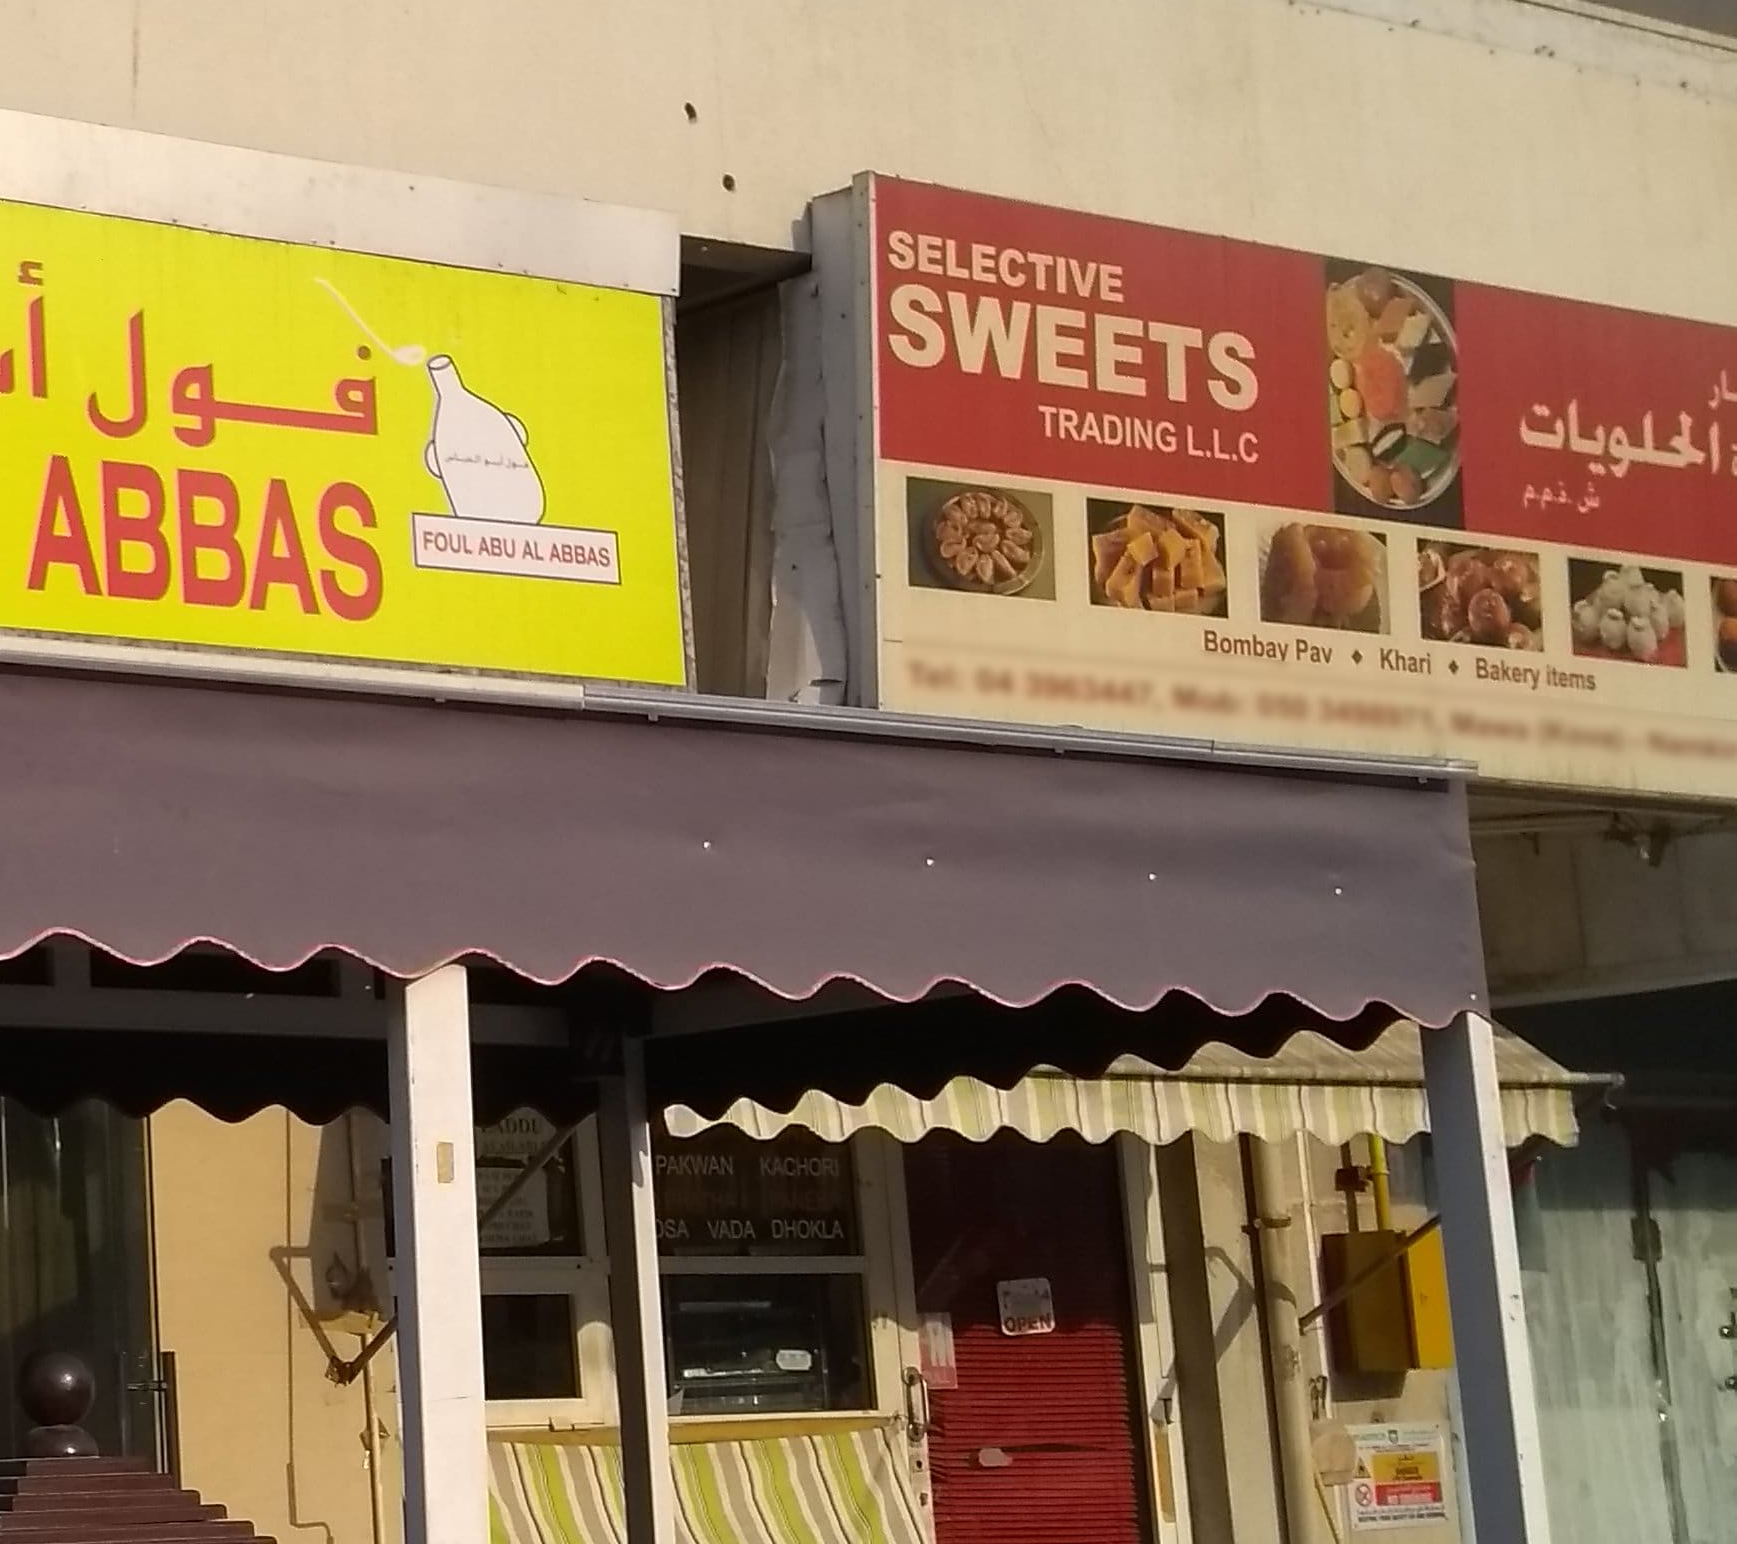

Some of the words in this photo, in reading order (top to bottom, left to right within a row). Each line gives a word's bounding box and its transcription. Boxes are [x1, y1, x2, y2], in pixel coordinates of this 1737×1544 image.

[888, 230, 1125, 304] SELECTIVE
[87, 309, 379, 447] فول
[888, 283, 1260, 412] SWEETS
[1038, 404, 1178, 453] TRADING
[1186, 425, 1260, 464] L.L.C
[1519, 399, 1720, 478] الحلويات
[27, 454, 384, 623] ABBAS
[423, 530, 473, 555] FOUL
[478, 537, 515, 559] ABU
[522, 541, 544, 562] AL
[549, 543, 611, 568] ABBAS
[1203, 630, 1289, 662] Bombay
[1295, 636, 1333, 665] Pav
[1379, 647, 1432, 676] Khari
[1475, 657, 1541, 691] Bakery
[1545, 662, 1597, 691] items
[655, 1155, 734, 1176] PAKWAN
[759, 1157, 840, 1177] KACHORI
[707, 1219, 757, 1240] VADA
[771, 1218, 845, 1240] DHOKLA
[1004, 1313, 1052, 1333] OPEN
